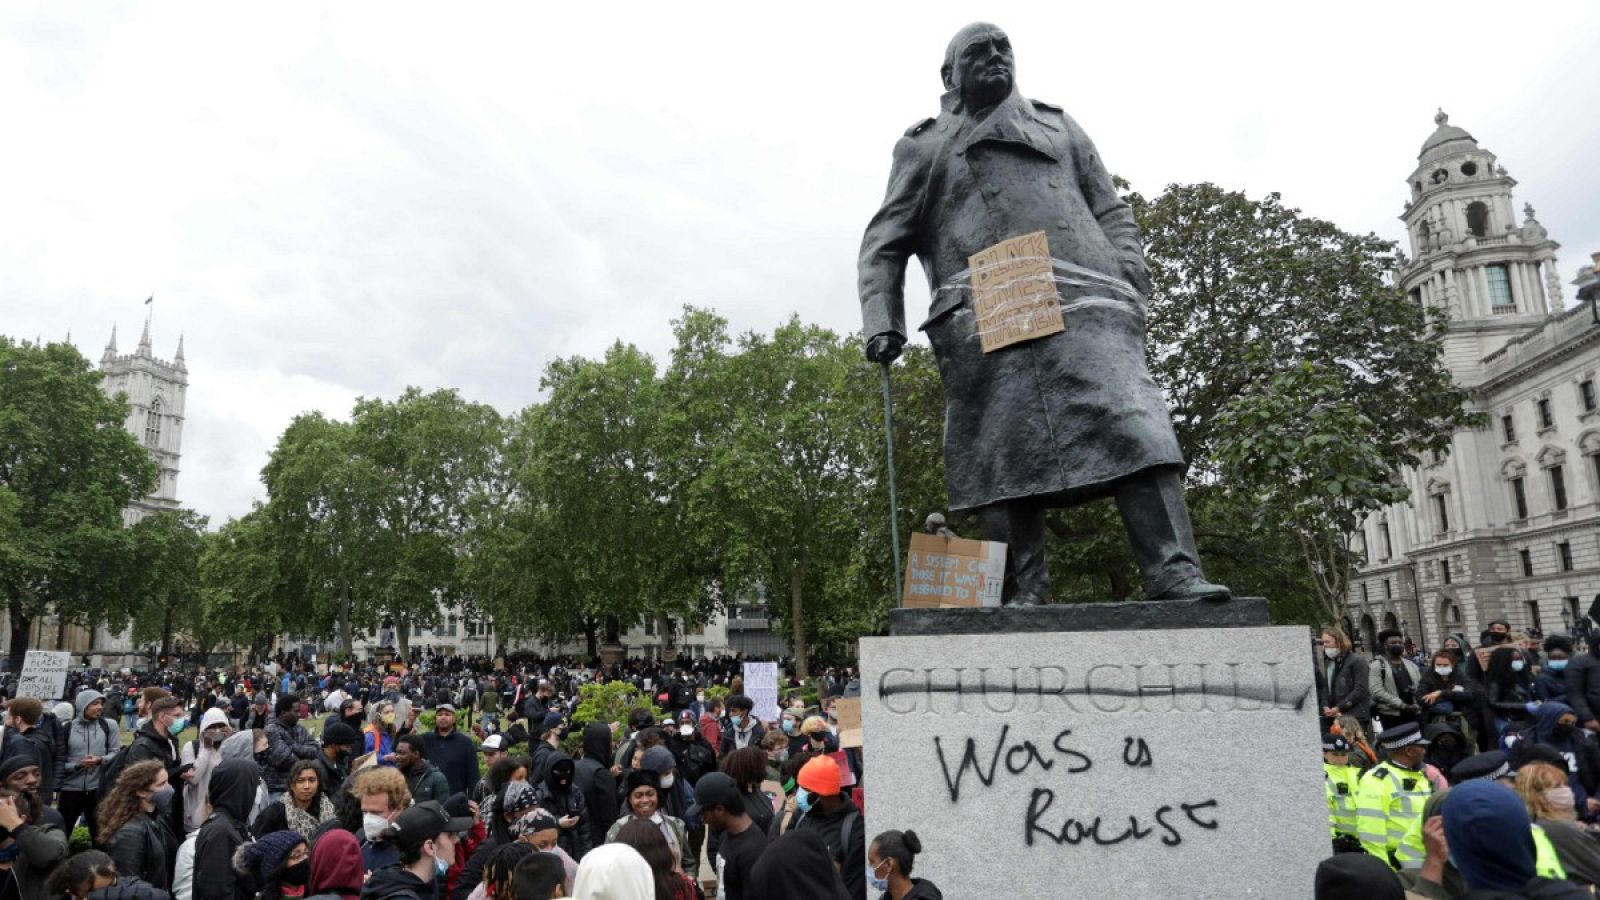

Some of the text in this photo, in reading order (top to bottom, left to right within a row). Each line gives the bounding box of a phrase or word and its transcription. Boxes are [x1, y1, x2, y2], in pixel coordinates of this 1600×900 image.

[974, 236, 1049, 288] BLACK
[977, 265, 1058, 319] LIVES
[879, 662, 1300, 713] CHURCHILL
[934, 725, 1153, 802] Was a
[1025, 788, 1218, 846] Racist
